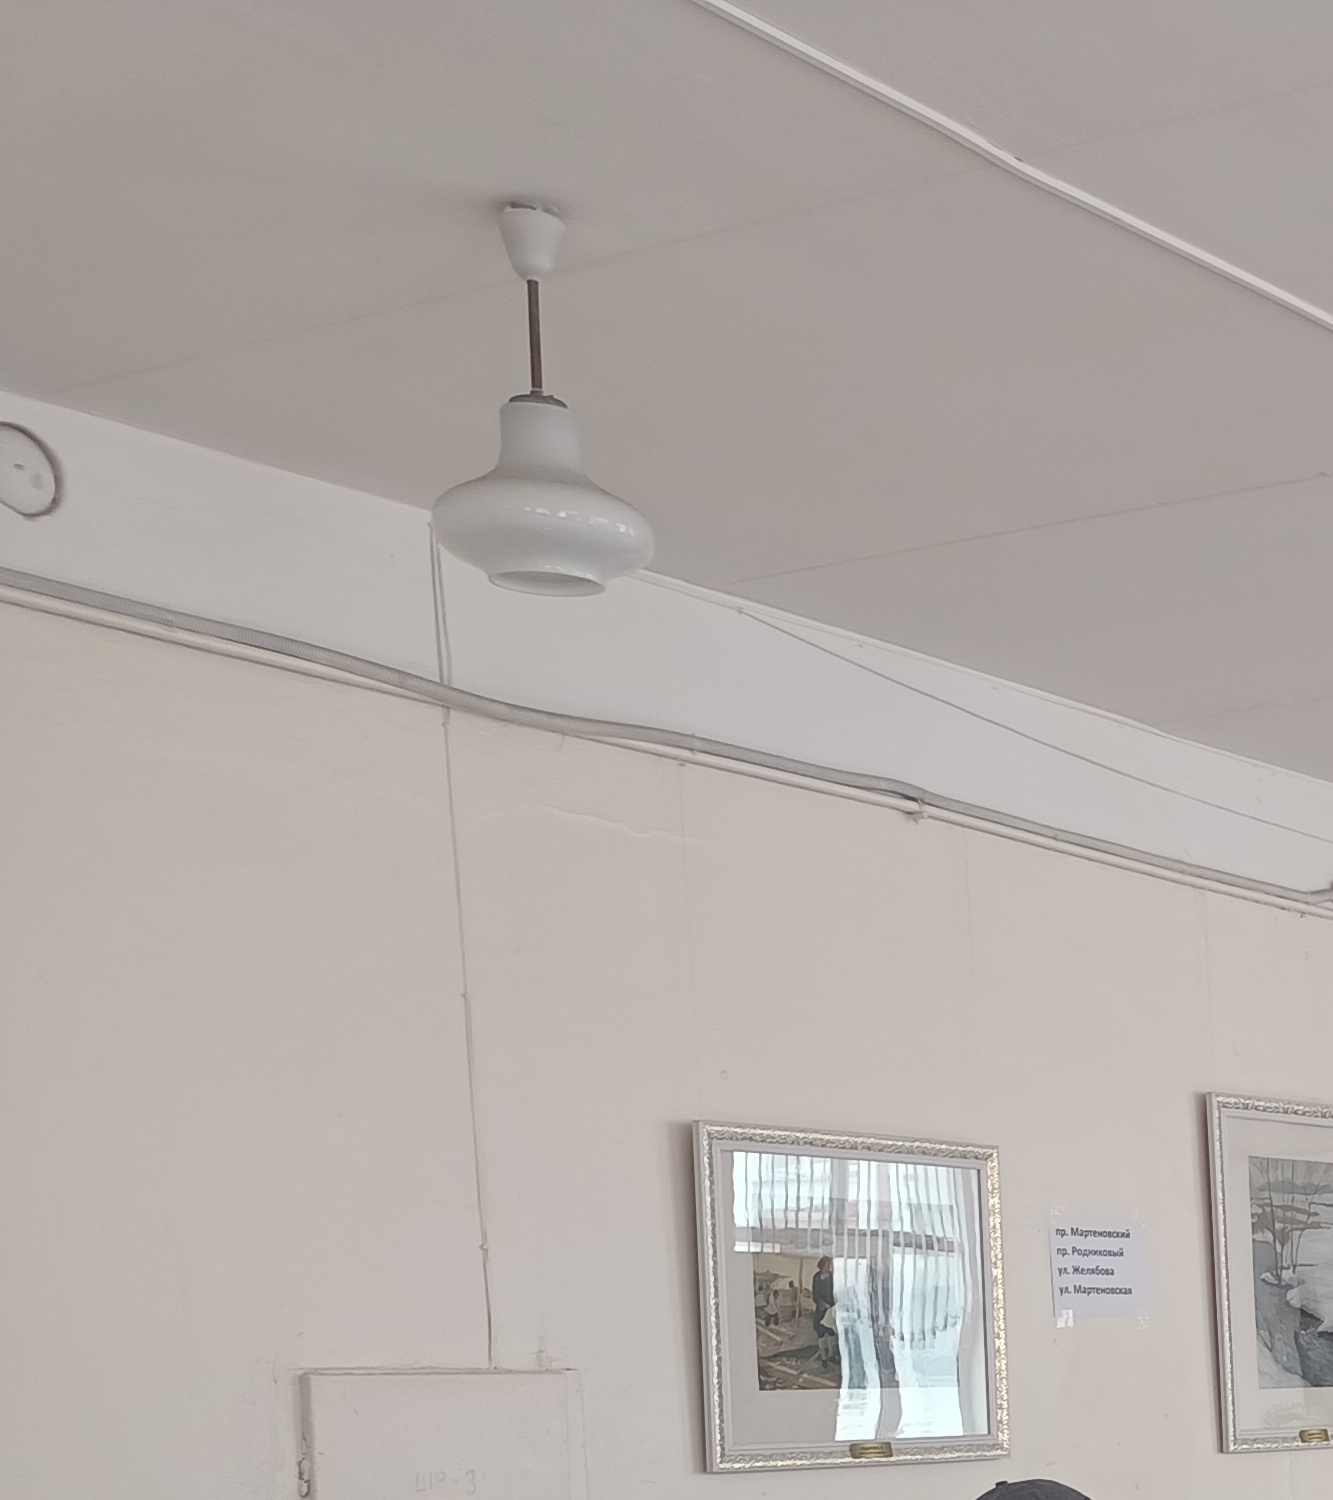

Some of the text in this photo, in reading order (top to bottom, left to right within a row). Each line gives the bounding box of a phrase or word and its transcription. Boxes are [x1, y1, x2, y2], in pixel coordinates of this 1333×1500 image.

[1055, 1226, 1131, 1239] пр. Мартеновский
[1056, 1245, 1125, 1258] пр. Родниковый
[1057, 1265, 1115, 1277] ул. Желябова
[1059, 1284, 1133, 1296] ул. Мартеновская
